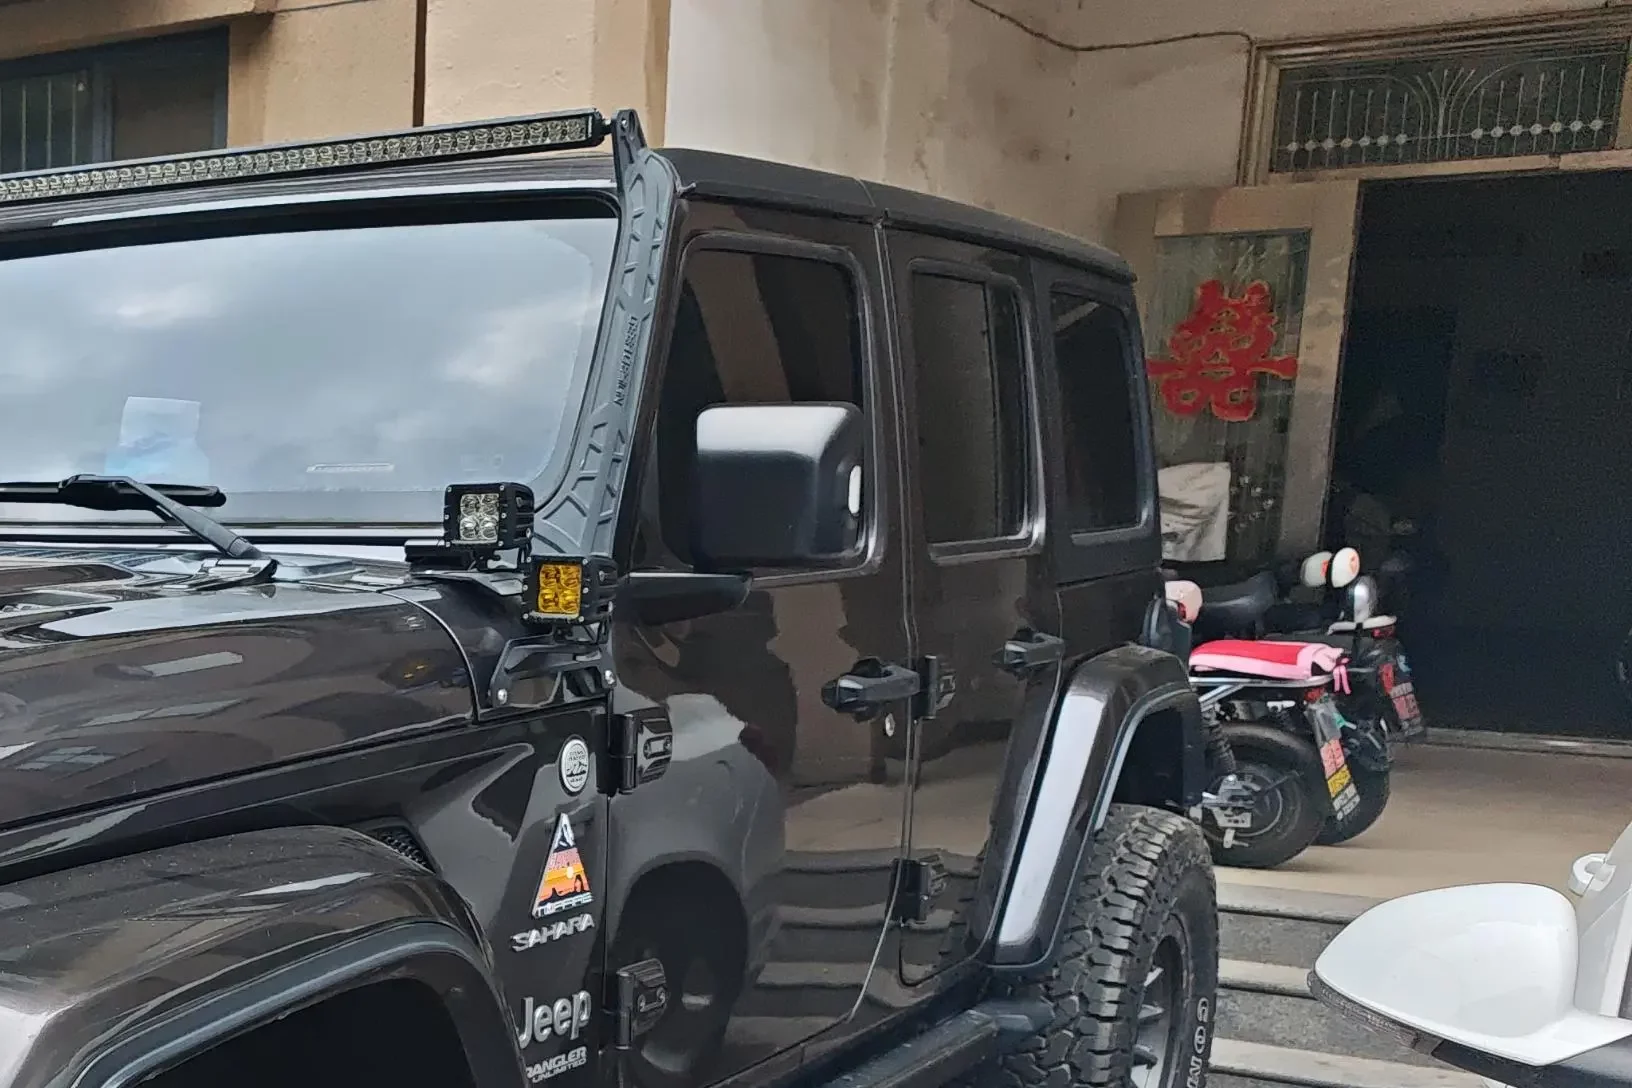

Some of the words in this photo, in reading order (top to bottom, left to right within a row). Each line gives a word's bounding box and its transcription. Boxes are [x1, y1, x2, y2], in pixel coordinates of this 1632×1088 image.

[510, 913, 595, 952] SAHARA
[518, 990, 592, 1049] Jeep
[525, 1046, 588, 1079] RANGLER
